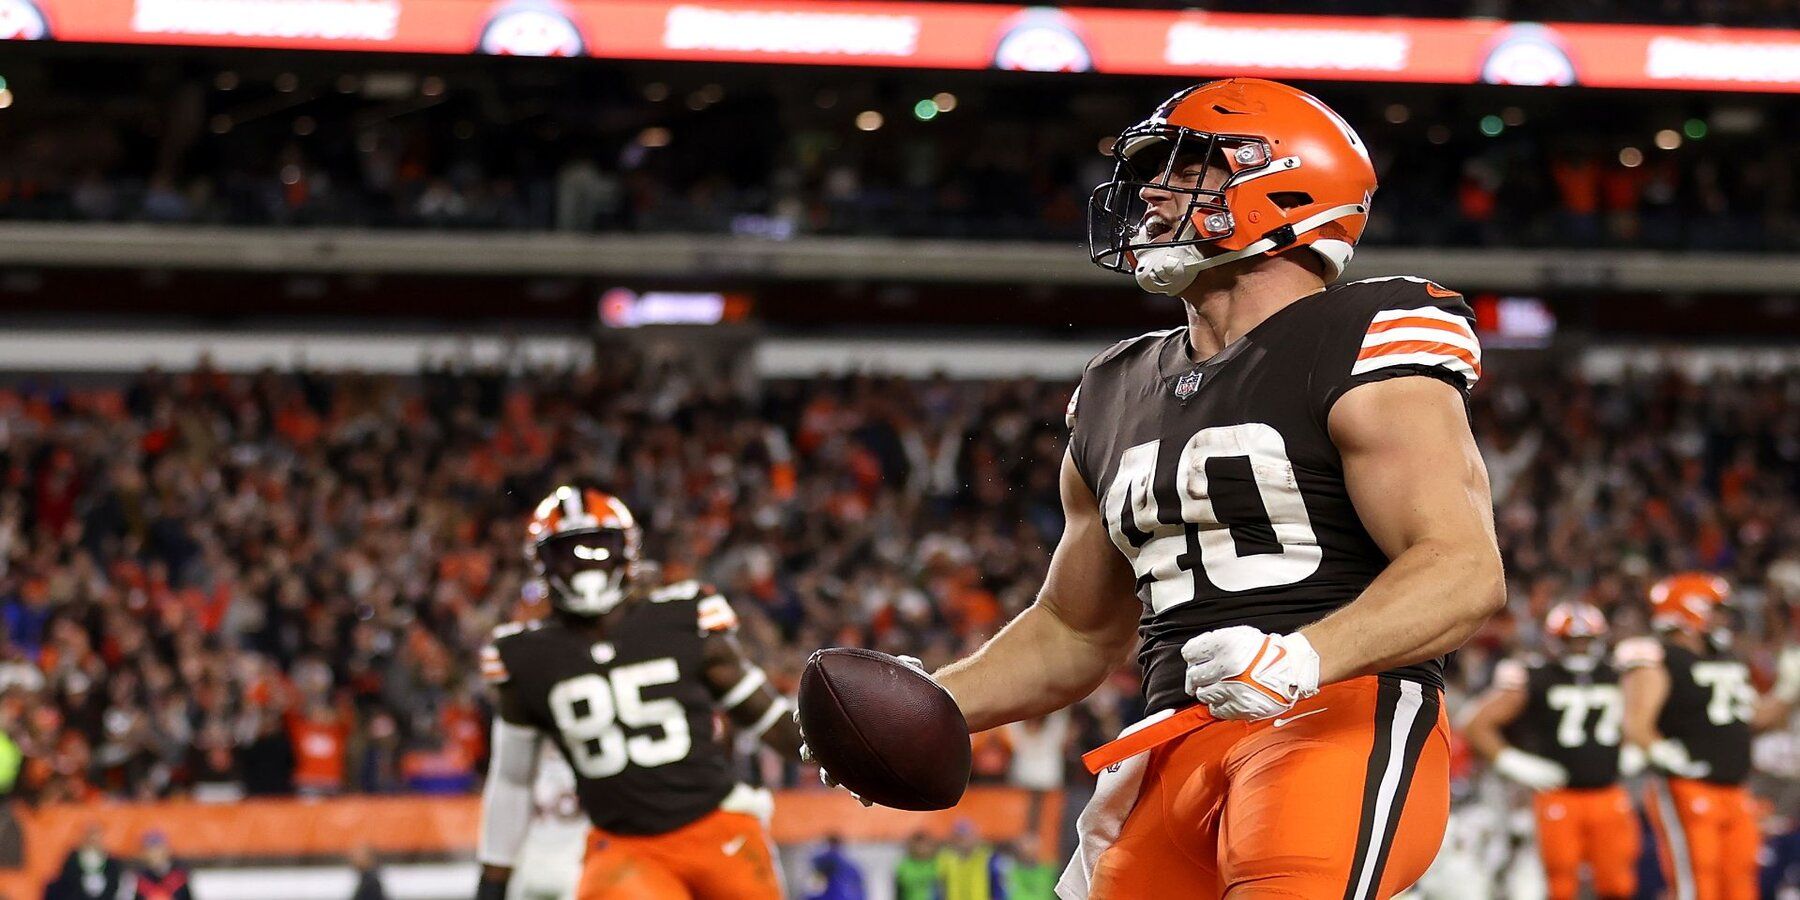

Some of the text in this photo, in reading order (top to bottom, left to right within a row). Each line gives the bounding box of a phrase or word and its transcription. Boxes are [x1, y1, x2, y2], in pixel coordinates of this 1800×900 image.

[1106, 423, 1322, 614] 40
[549, 659, 691, 778] 85
[1547, 684, 1624, 748] 77
